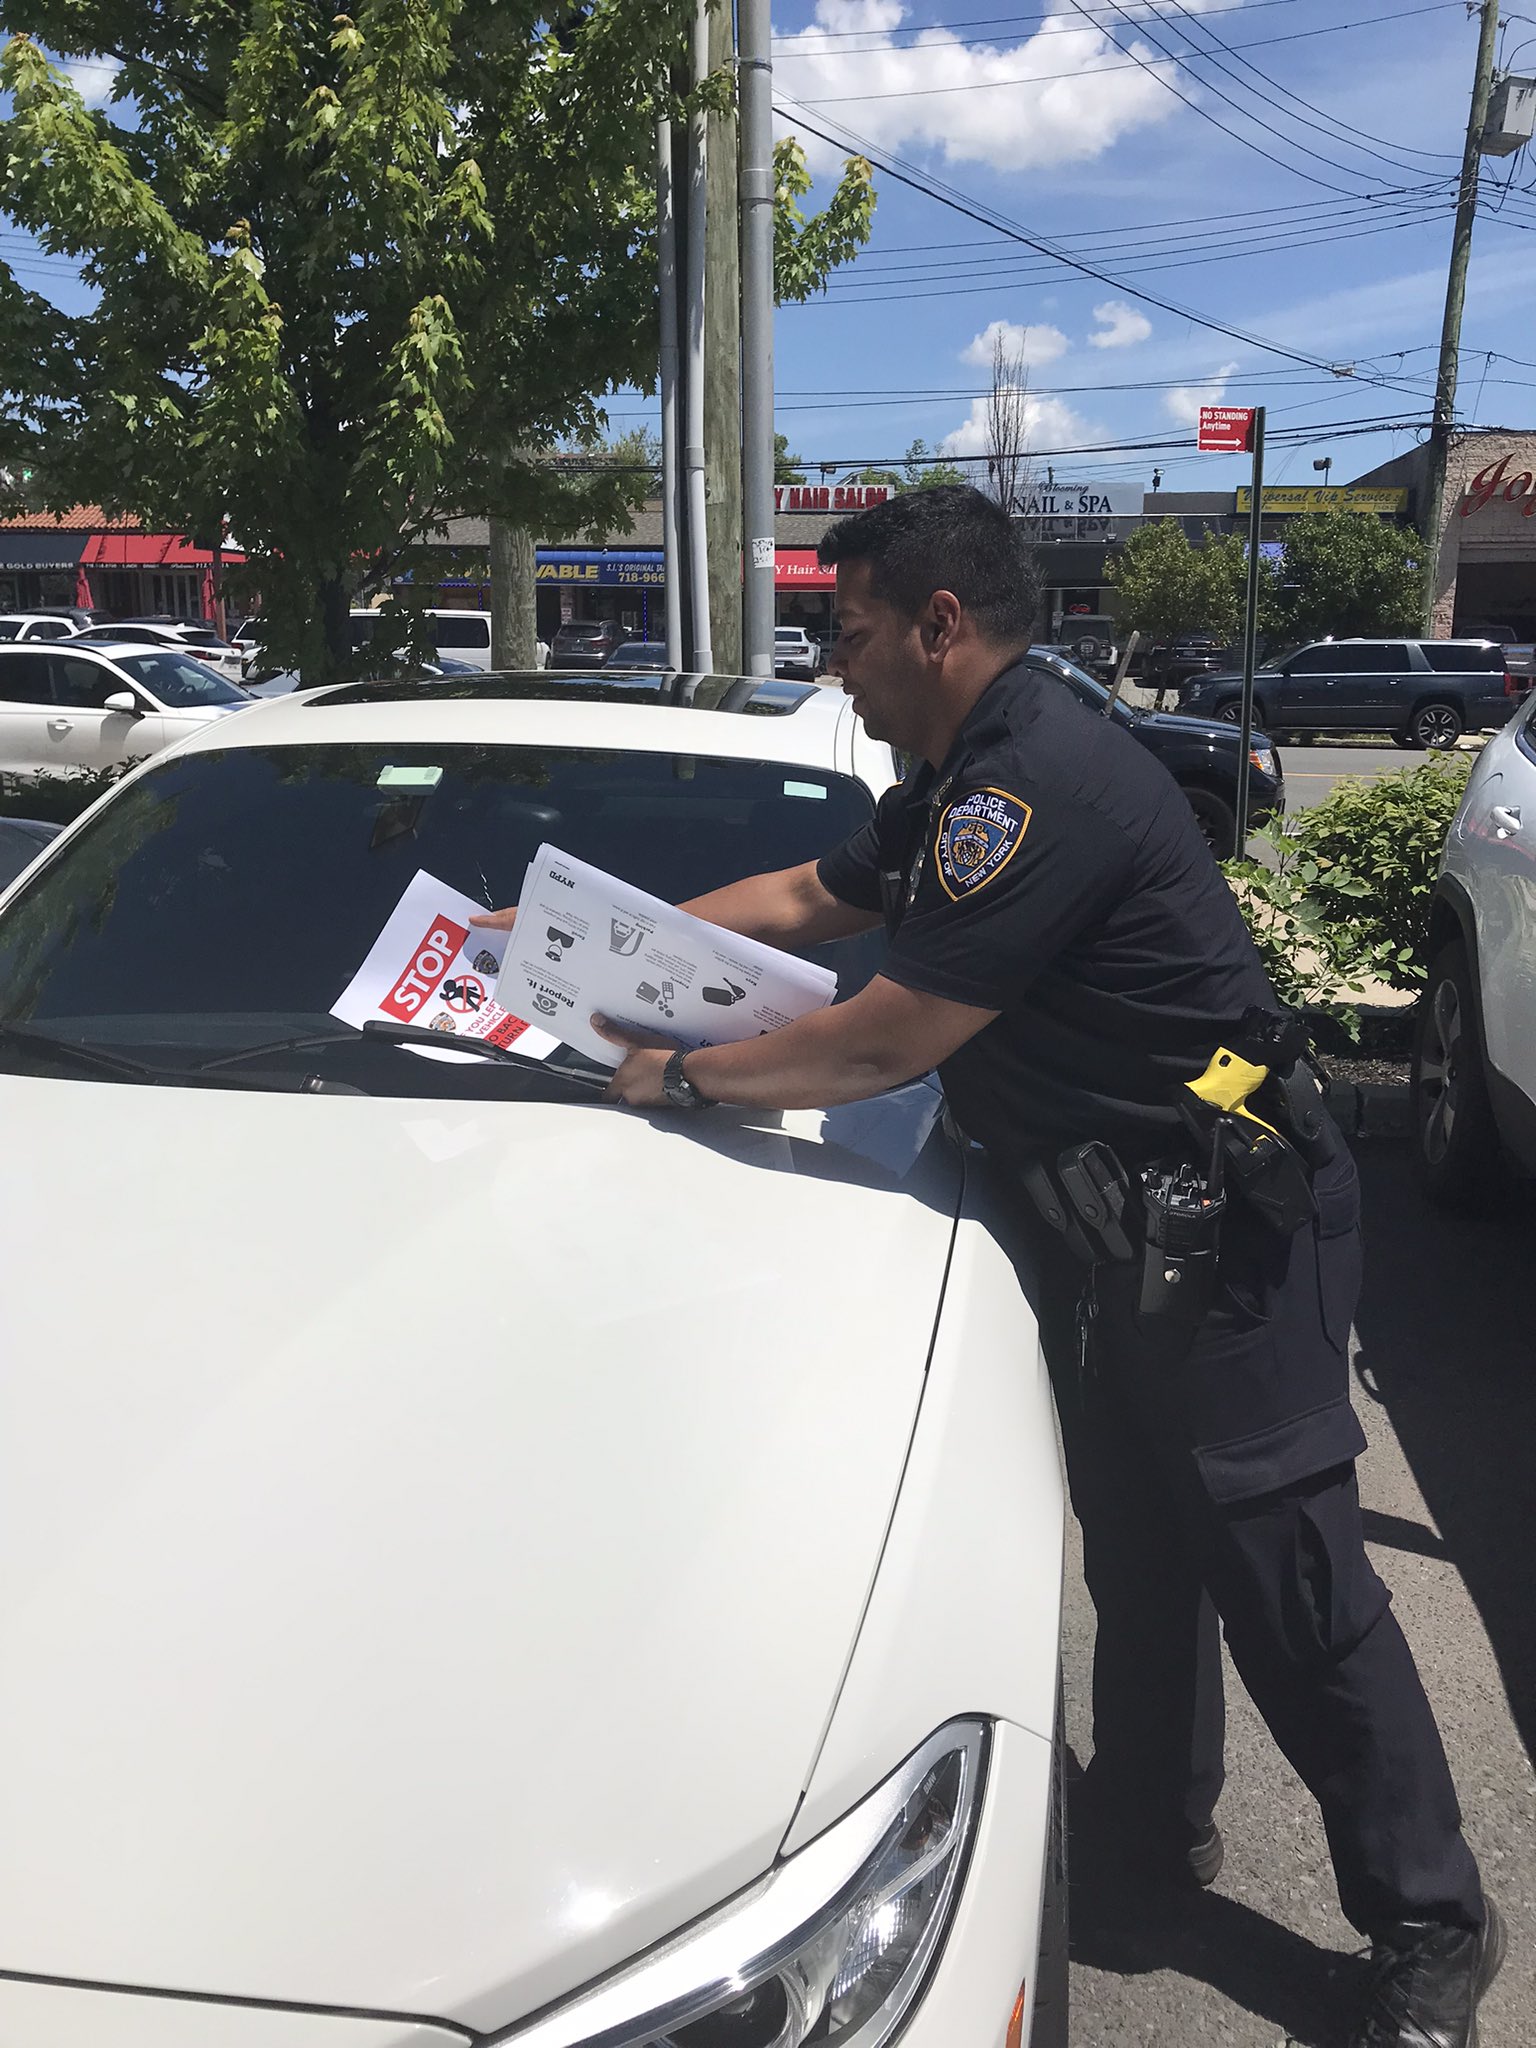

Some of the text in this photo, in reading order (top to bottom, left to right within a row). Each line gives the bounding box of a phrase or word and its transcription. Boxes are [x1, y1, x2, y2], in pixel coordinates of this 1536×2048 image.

[1202, 411, 1248, 420] NO STANDING
[1202, 421, 1231, 431] Anytime
[1038, 481, 1089, 495] Blooming
[1461, 452, 1536, 518] Jo
[789, 487, 830, 509] HAIR
[1011, 495, 1112, 513] NAIL & SPA
[6, 562, 33, 570] GOLD
[787, 564, 816, 575] Hair
[966, 794, 1006, 812] POLICE
[948, 805, 1018, 832] DEPARTMENT
[940, 832, 1014, 888] CITY OF NEW YORK
[549, 870, 576, 889] NYPD
[393, 928, 455, 1013] STOP
[526, 978, 538, 989] It.
[540, 984, 575, 1008] Report
[465, 1016, 485, 1033] YOU
[498, 1026, 524, 1048] TURN
[922, 1771, 937, 1795] BMW
